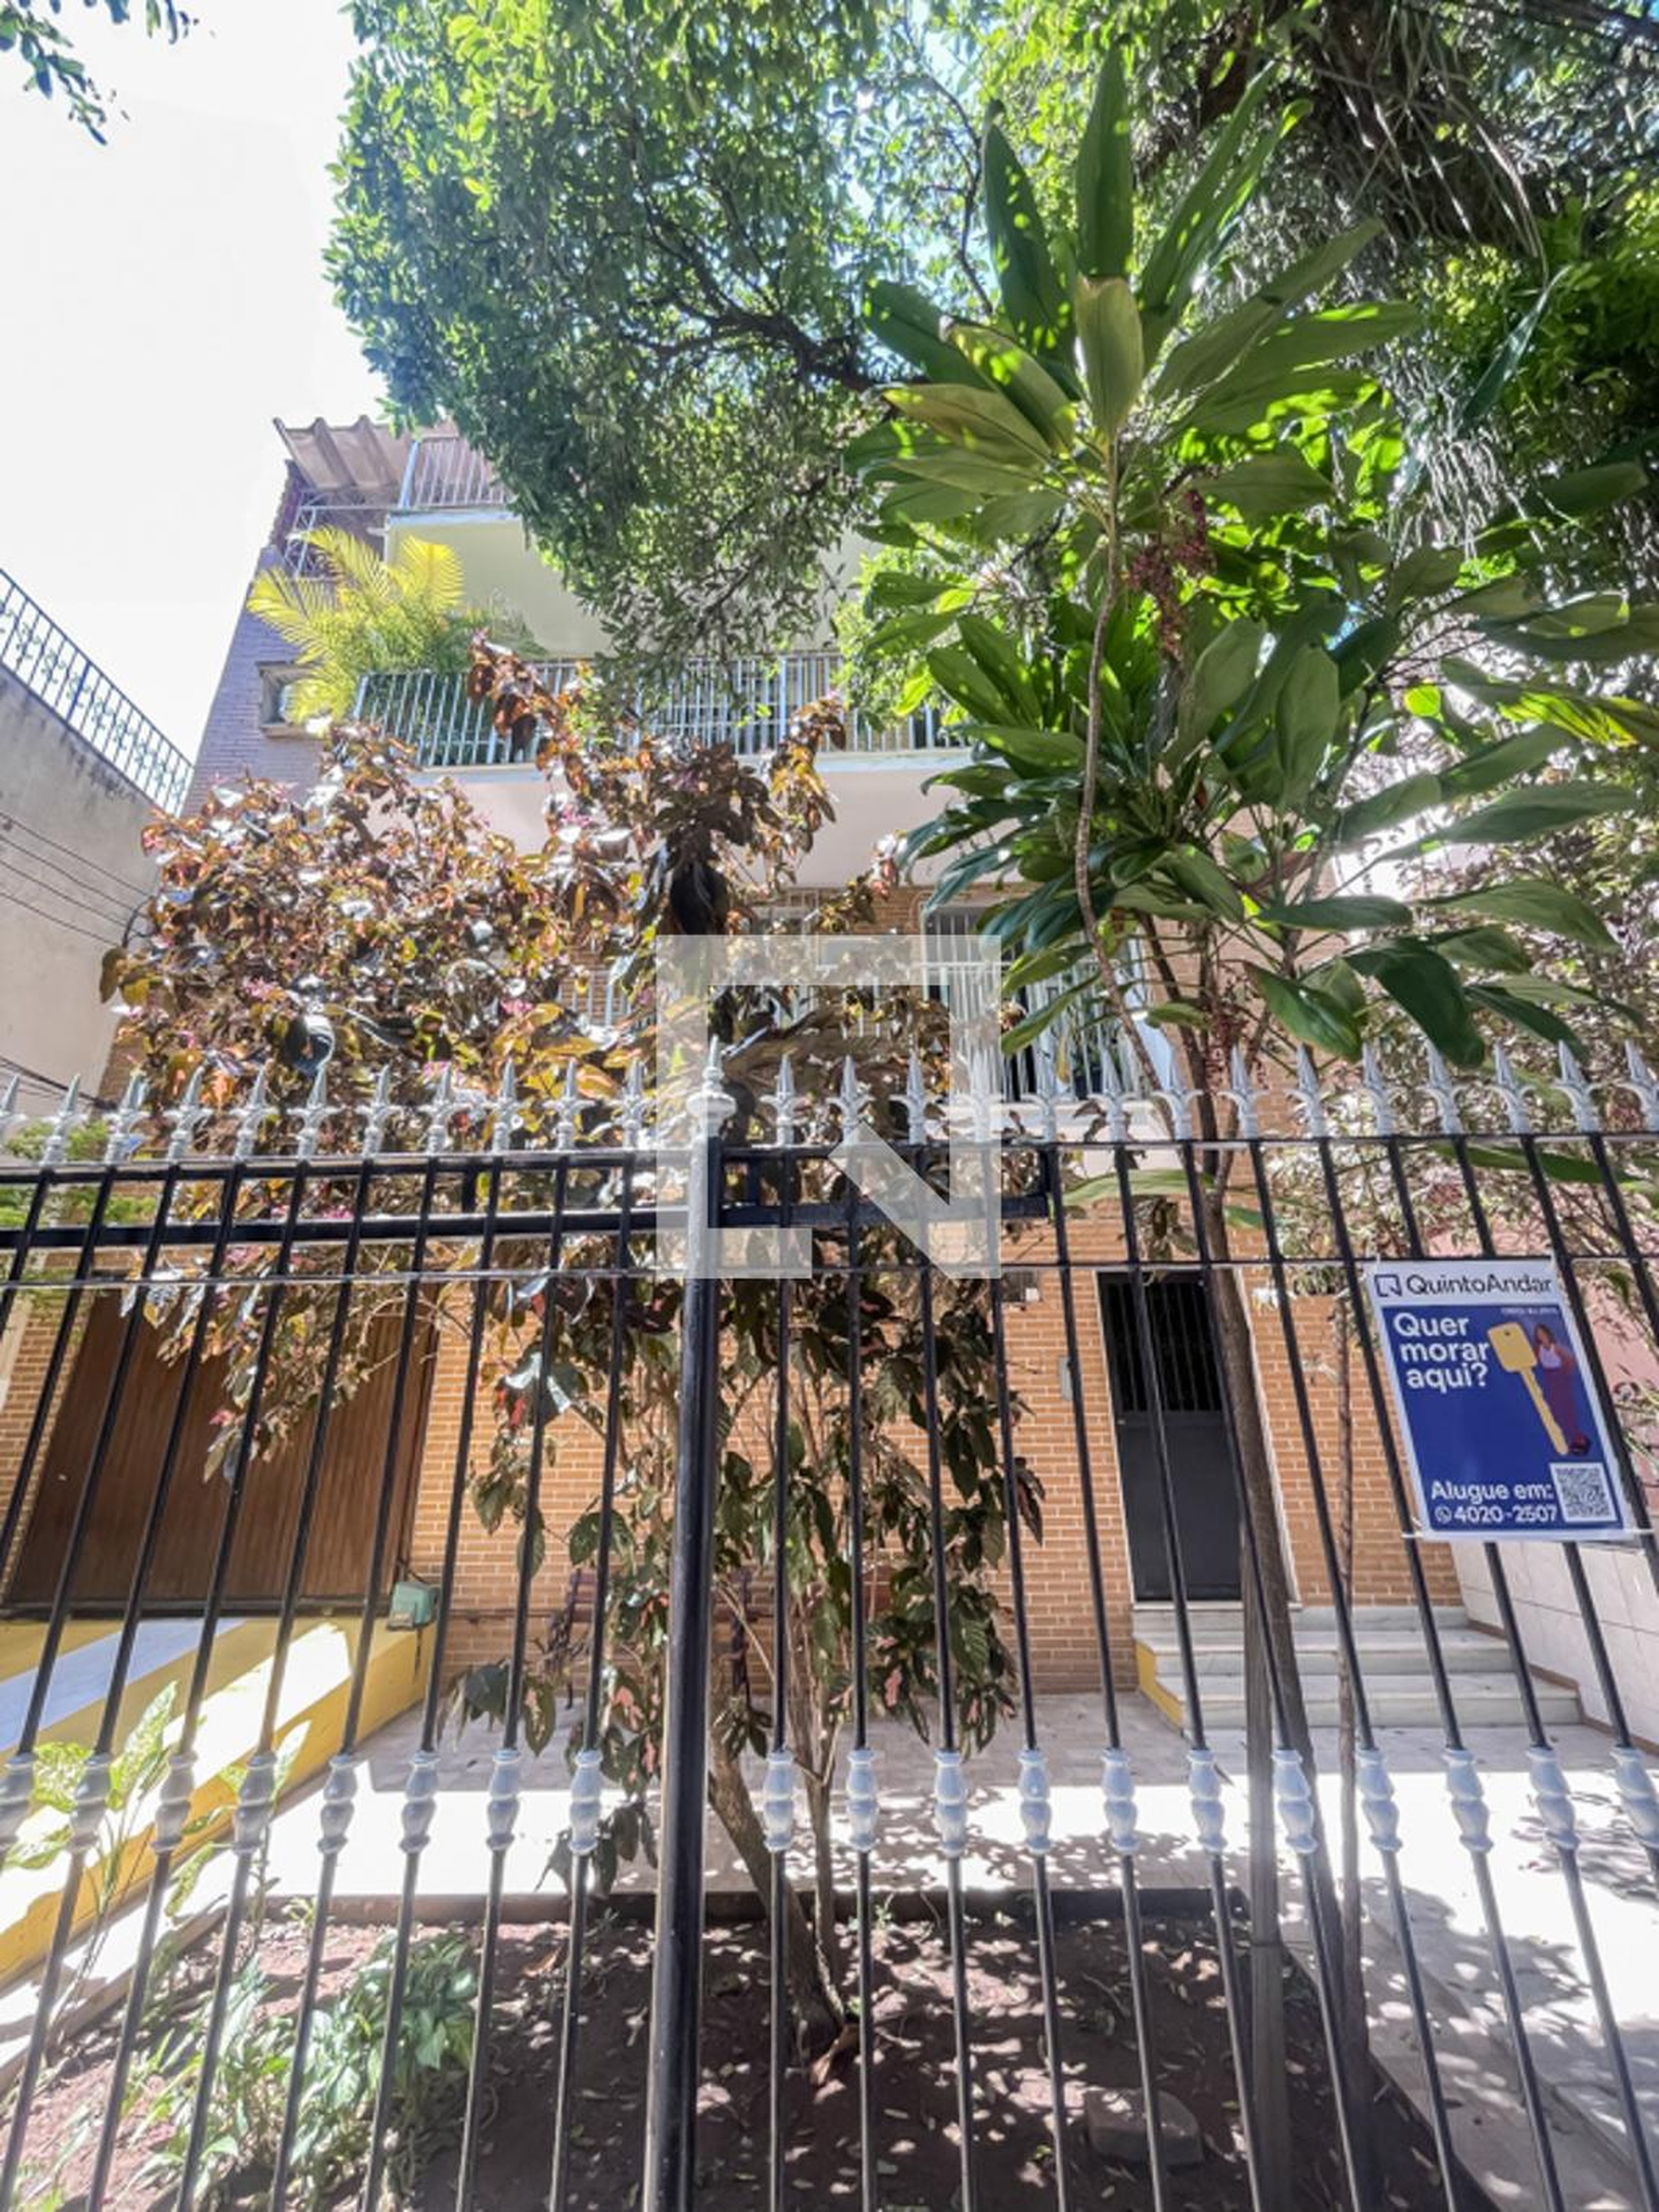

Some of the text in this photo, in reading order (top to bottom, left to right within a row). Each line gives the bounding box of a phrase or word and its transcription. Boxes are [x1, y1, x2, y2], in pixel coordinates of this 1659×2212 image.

[1406, 1274, 1552, 1295] QuintoAndar
[1393, 1312, 1469, 1337] Quer
[1400, 1342, 1490, 1362] morar
[1405, 1362, 1488, 1394] aqui?
[1431, 1480, 1554, 1505] Alugue em:
[1454, 1504, 1557, 1523] 4020-2507
